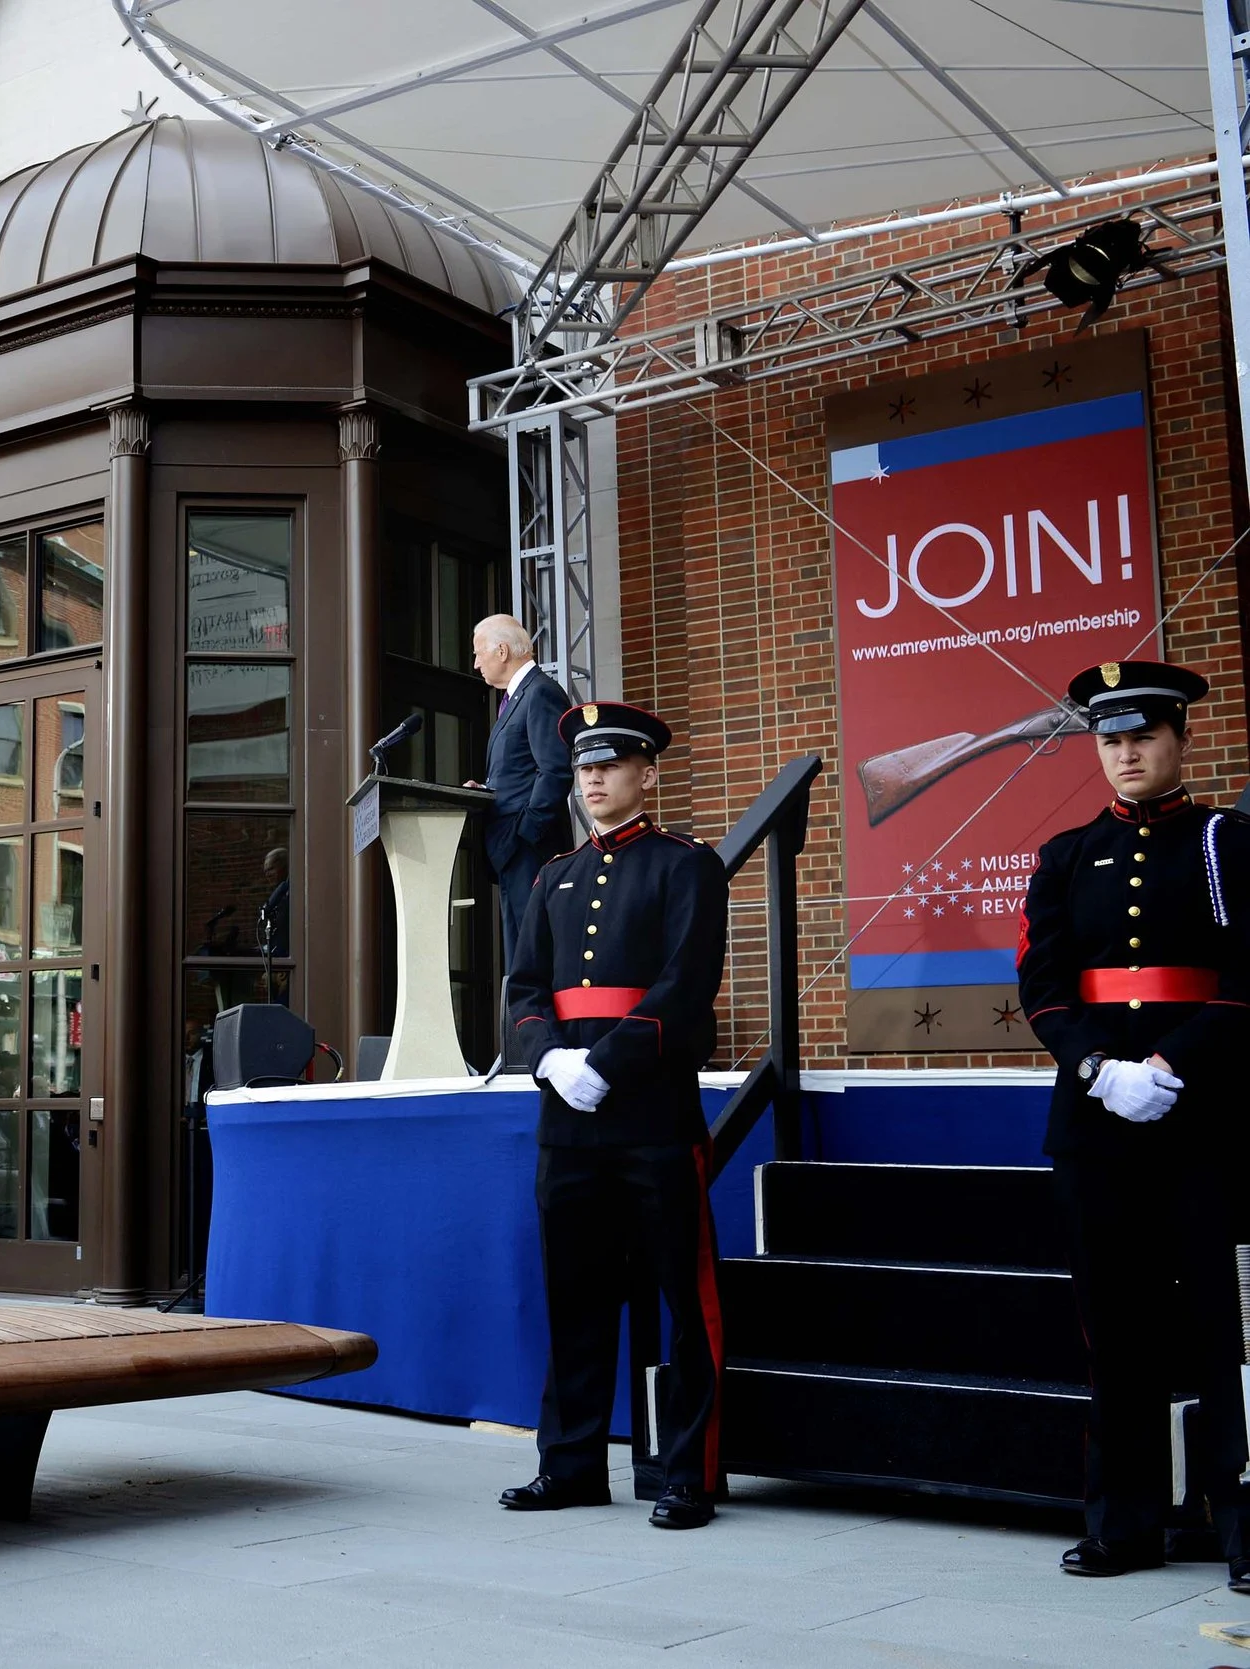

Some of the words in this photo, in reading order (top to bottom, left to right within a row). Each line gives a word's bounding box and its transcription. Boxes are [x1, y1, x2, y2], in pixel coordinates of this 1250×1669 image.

[856, 494, 1133, 619] JOIN!
[852, 608, 1140, 661] www.amrevmuseum.org/membership
[980, 853, 1035, 872] MUSE
